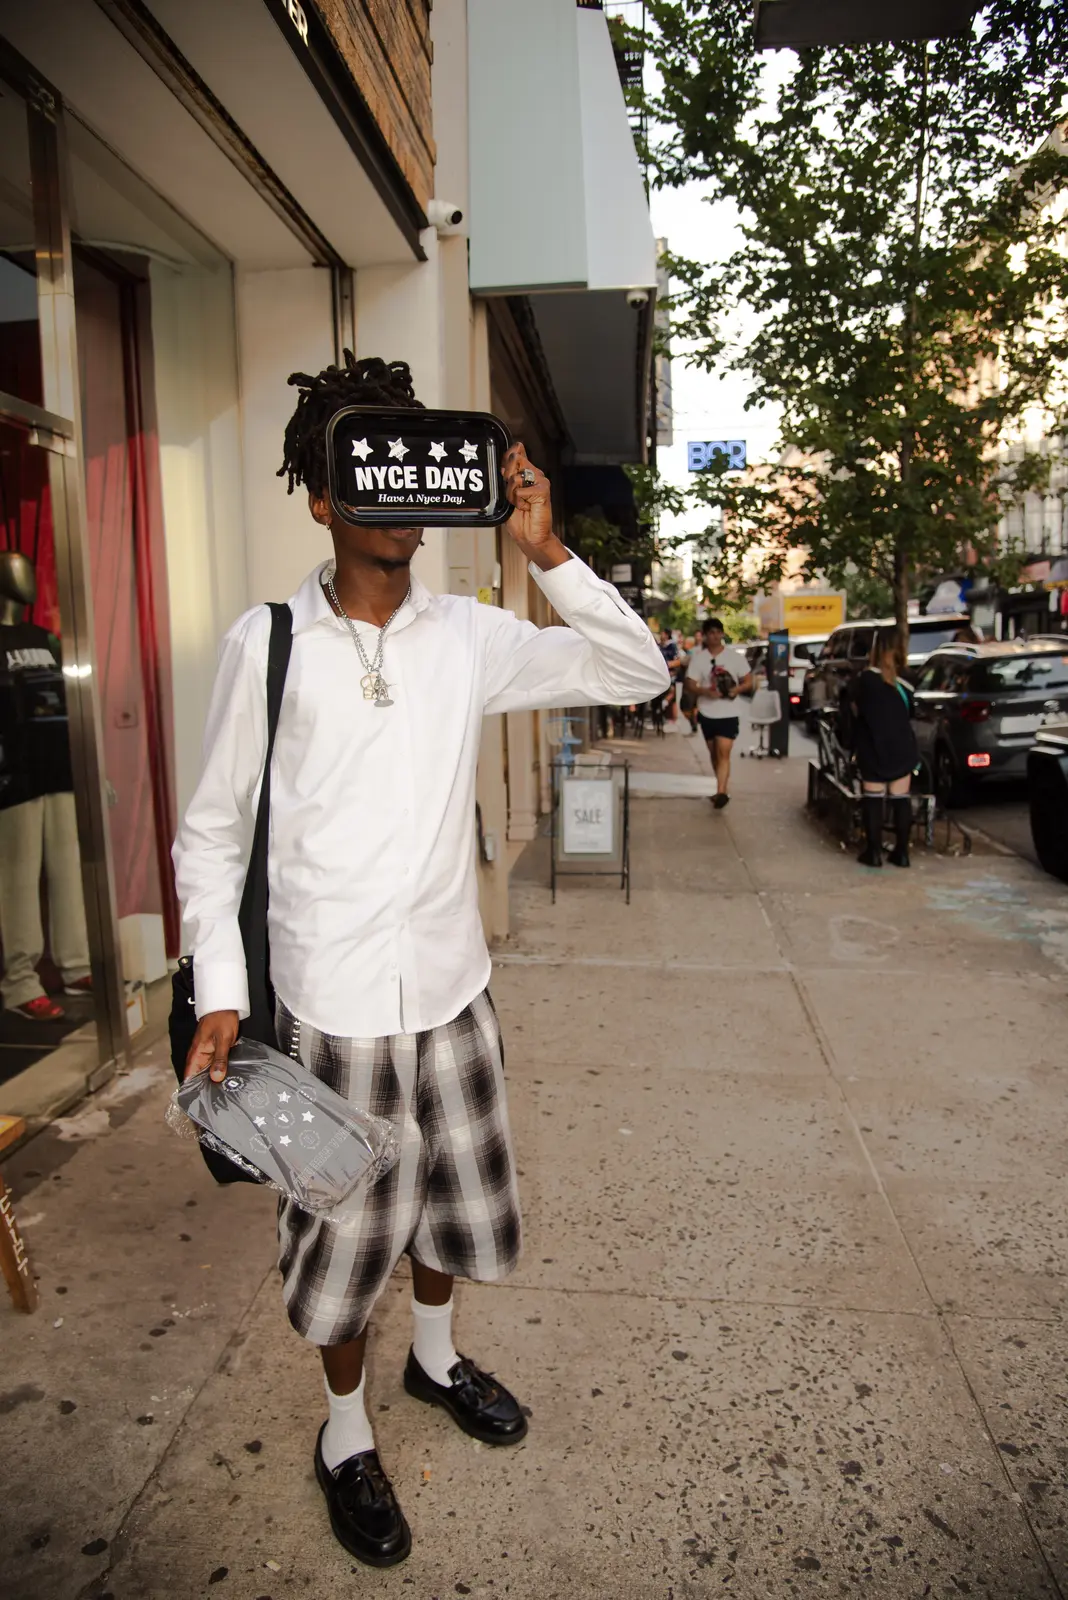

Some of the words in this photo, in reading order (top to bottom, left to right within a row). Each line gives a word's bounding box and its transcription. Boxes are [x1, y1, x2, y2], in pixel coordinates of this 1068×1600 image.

[354, 465, 419, 491] NYCE
[425, 466, 484, 492] DAYS
[377, 494, 405, 503] Have
[406, 494, 414, 502] A
[416, 494, 441, 504] Nyce
[442, 494, 466, 504] Day.
[574, 809, 602, 824] SALE
